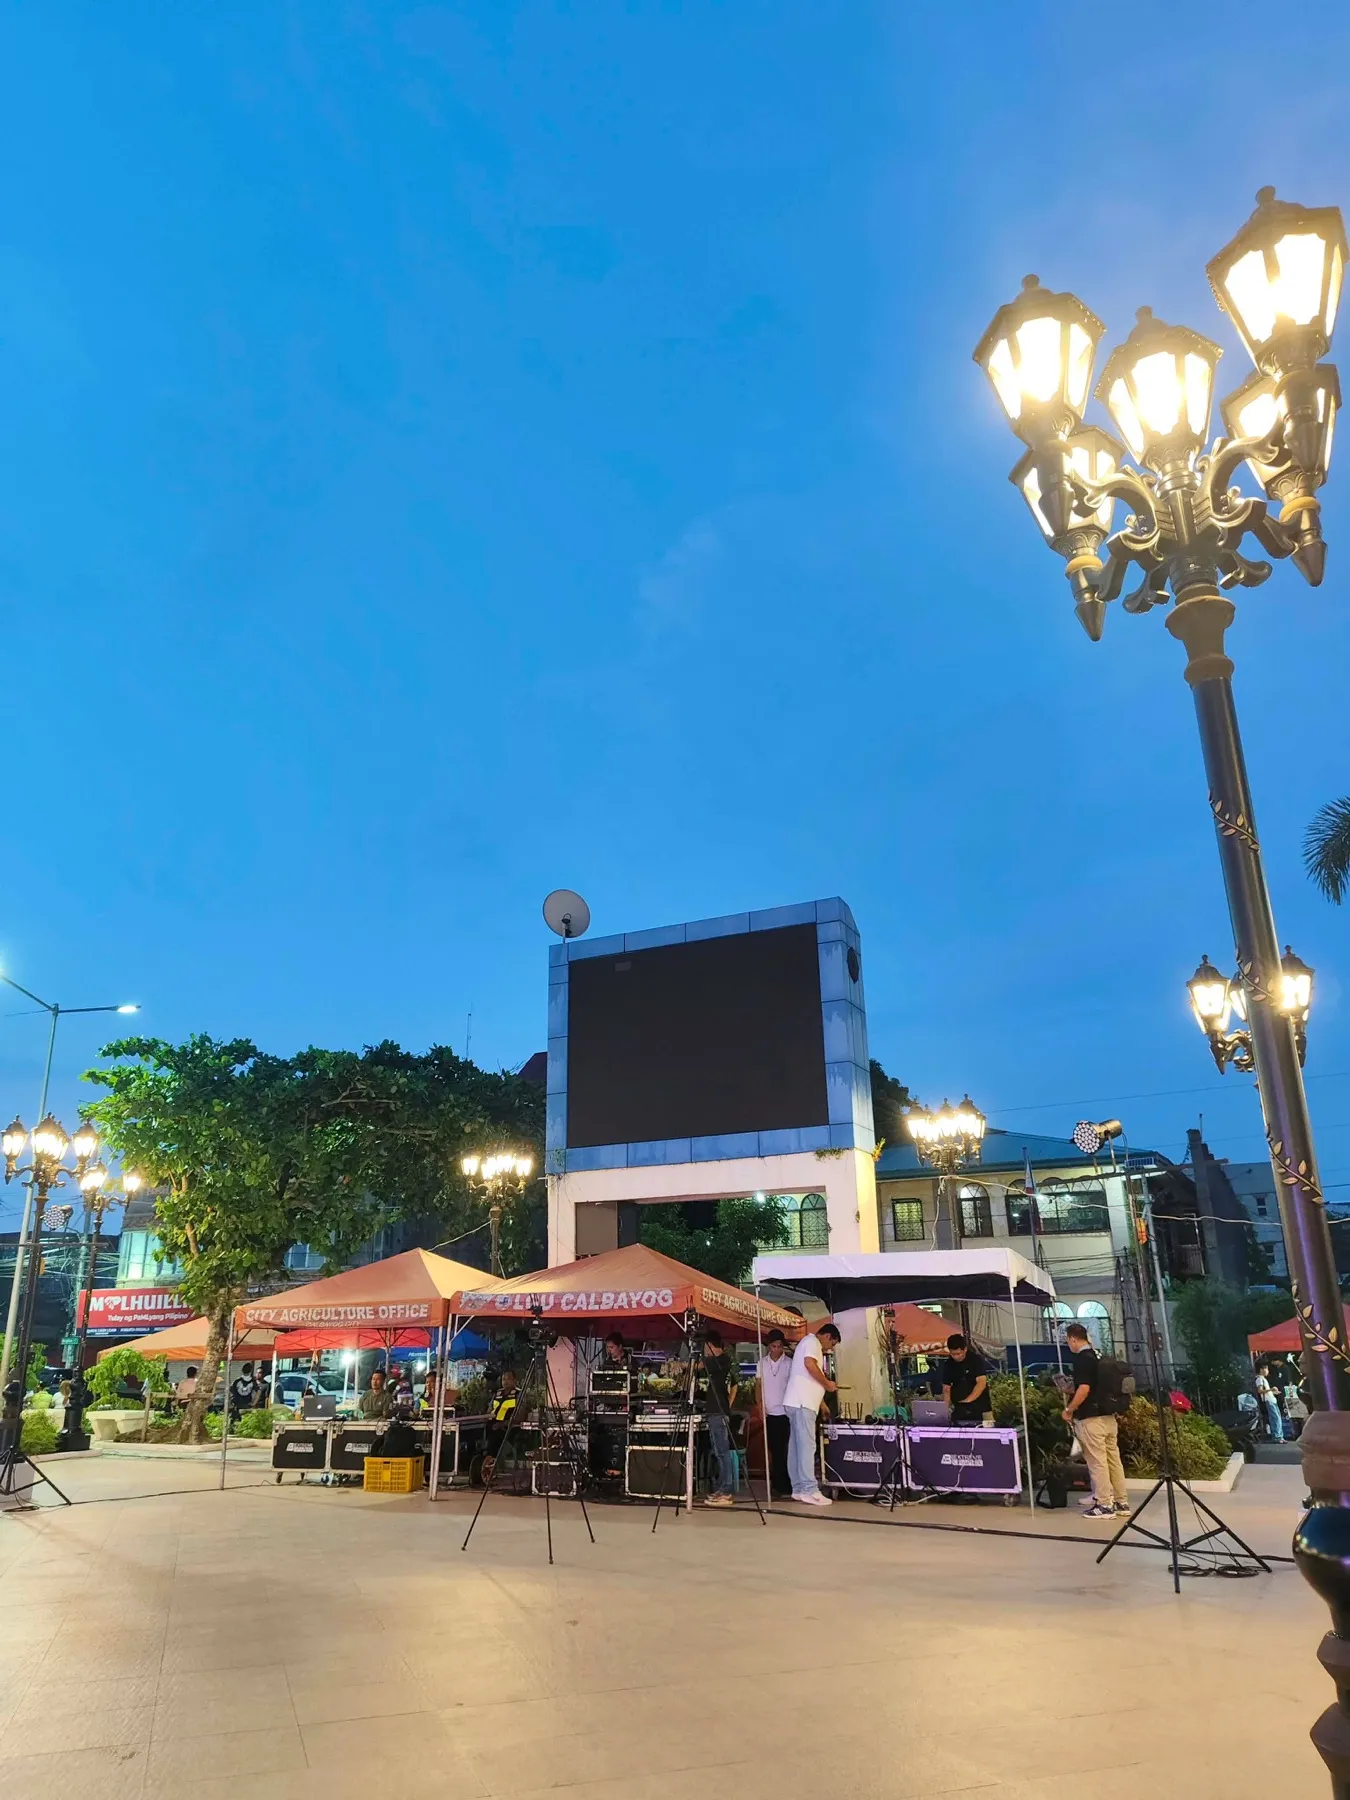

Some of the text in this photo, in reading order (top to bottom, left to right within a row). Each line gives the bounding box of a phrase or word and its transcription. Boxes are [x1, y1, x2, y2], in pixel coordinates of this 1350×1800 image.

[560, 1289, 674, 1311] CALBAYOG
[246, 1304, 429, 1322] CITY AGRICULTURE OFFICE
